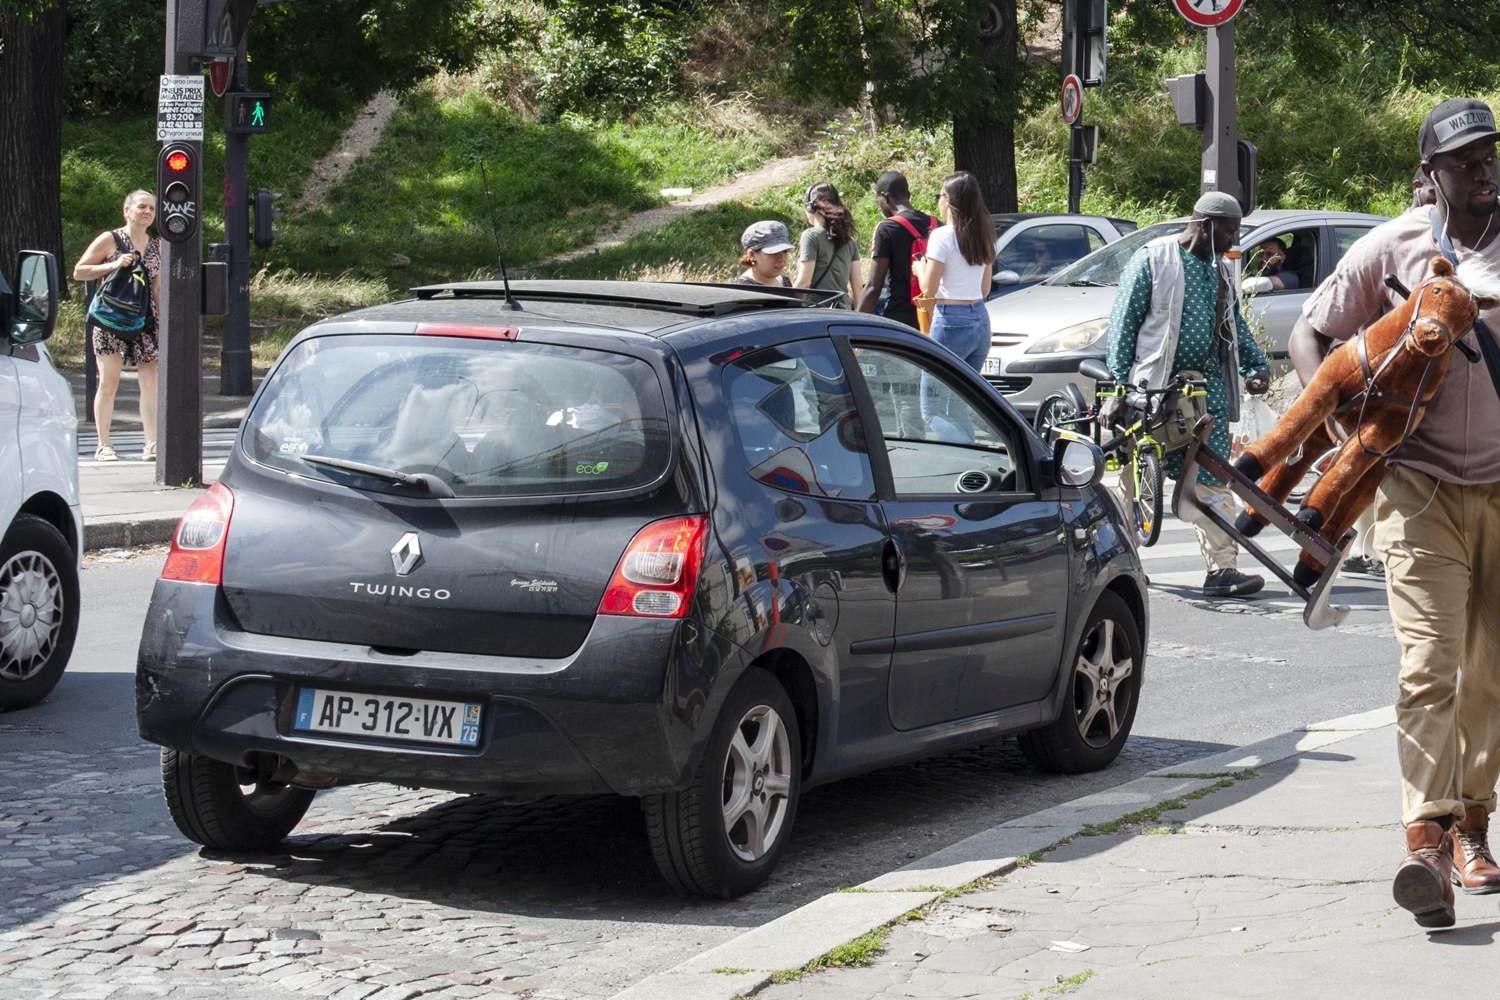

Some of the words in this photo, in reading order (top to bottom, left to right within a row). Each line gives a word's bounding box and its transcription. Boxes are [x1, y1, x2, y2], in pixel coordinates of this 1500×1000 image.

[1449, 112, 1491, 130] WAZZUP?
[280, 443, 298, 453] elf
[350, 582, 451, 599] TWINGO
[300, 713, 307, 722] F
[319, 695, 456, 738] AP-312-VX
[463, 726, 478, 742] 76
